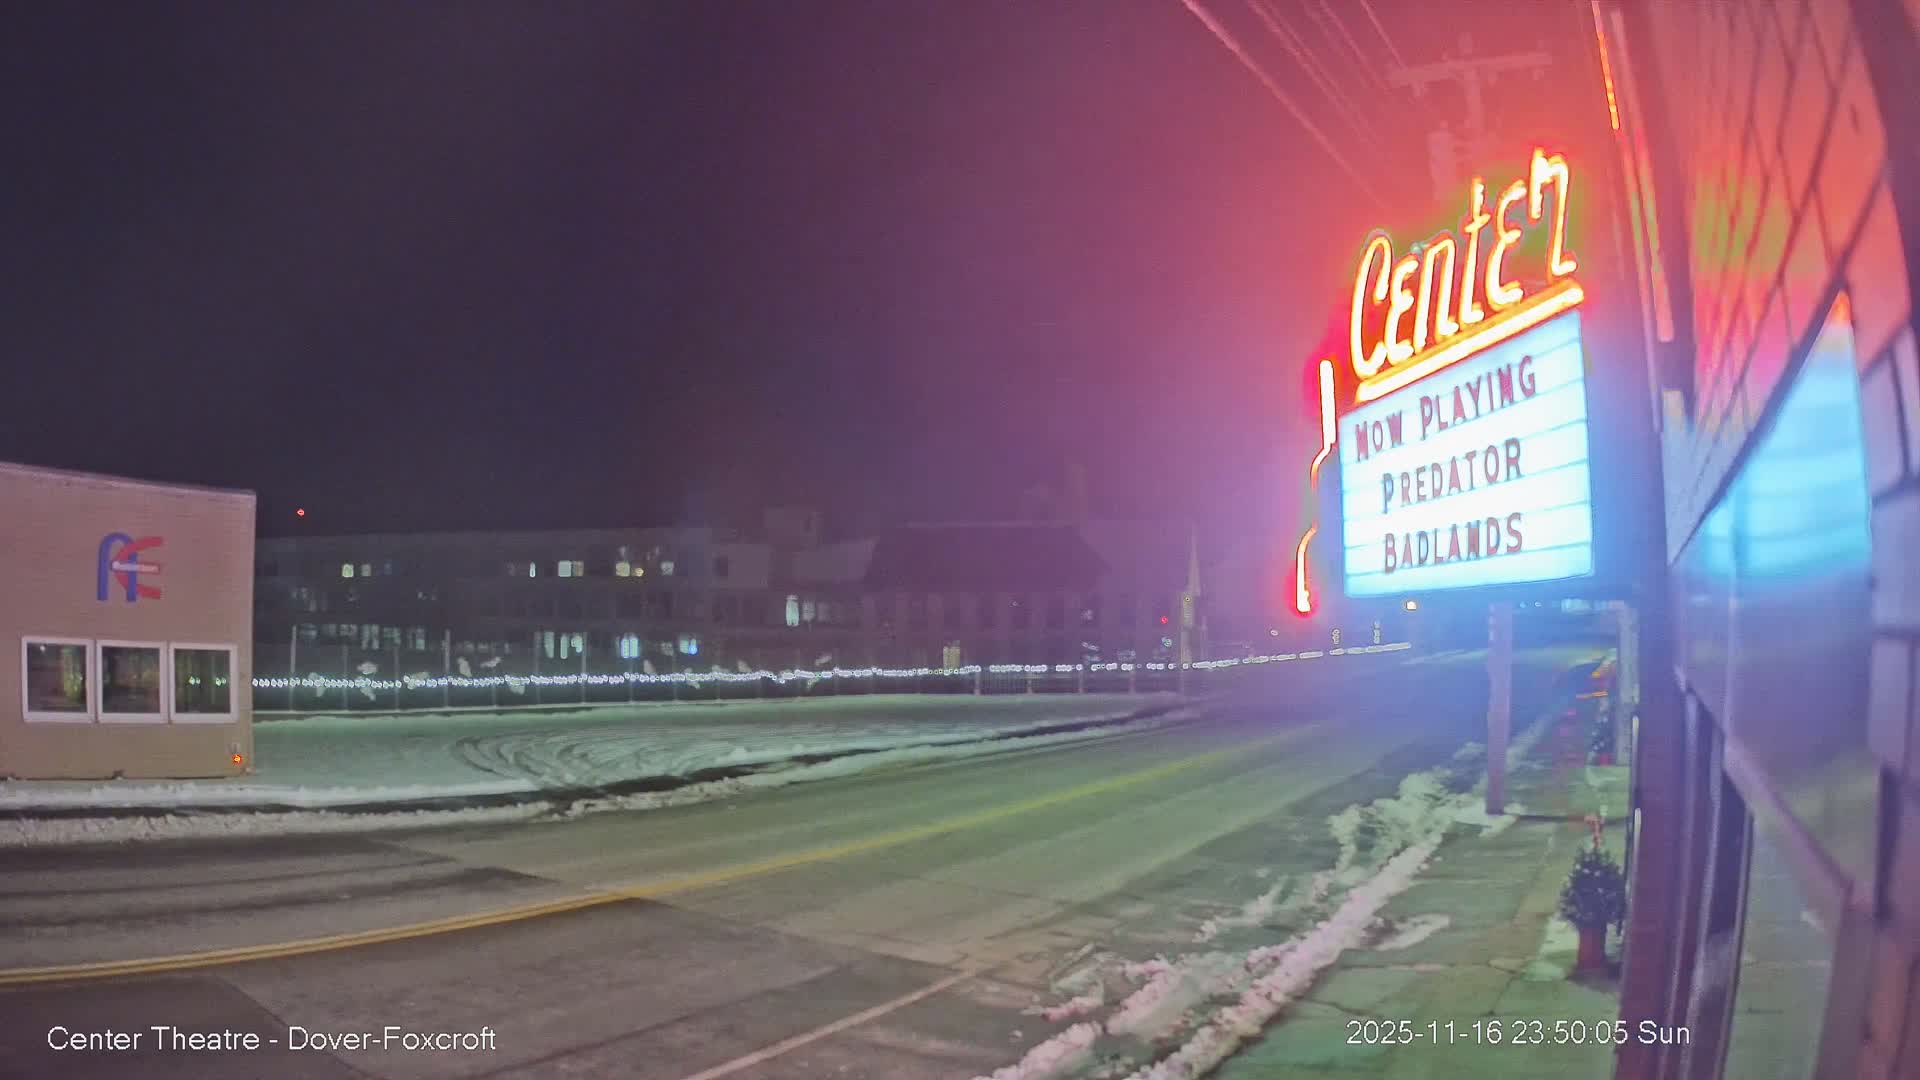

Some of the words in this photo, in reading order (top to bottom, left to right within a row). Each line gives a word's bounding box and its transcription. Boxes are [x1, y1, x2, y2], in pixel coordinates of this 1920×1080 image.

[1419, 356, 1537, 440] PLAYING
[1382, 437, 1523, 514] PREDATOR
[1384, 512, 1524, 574] BADLANDS
